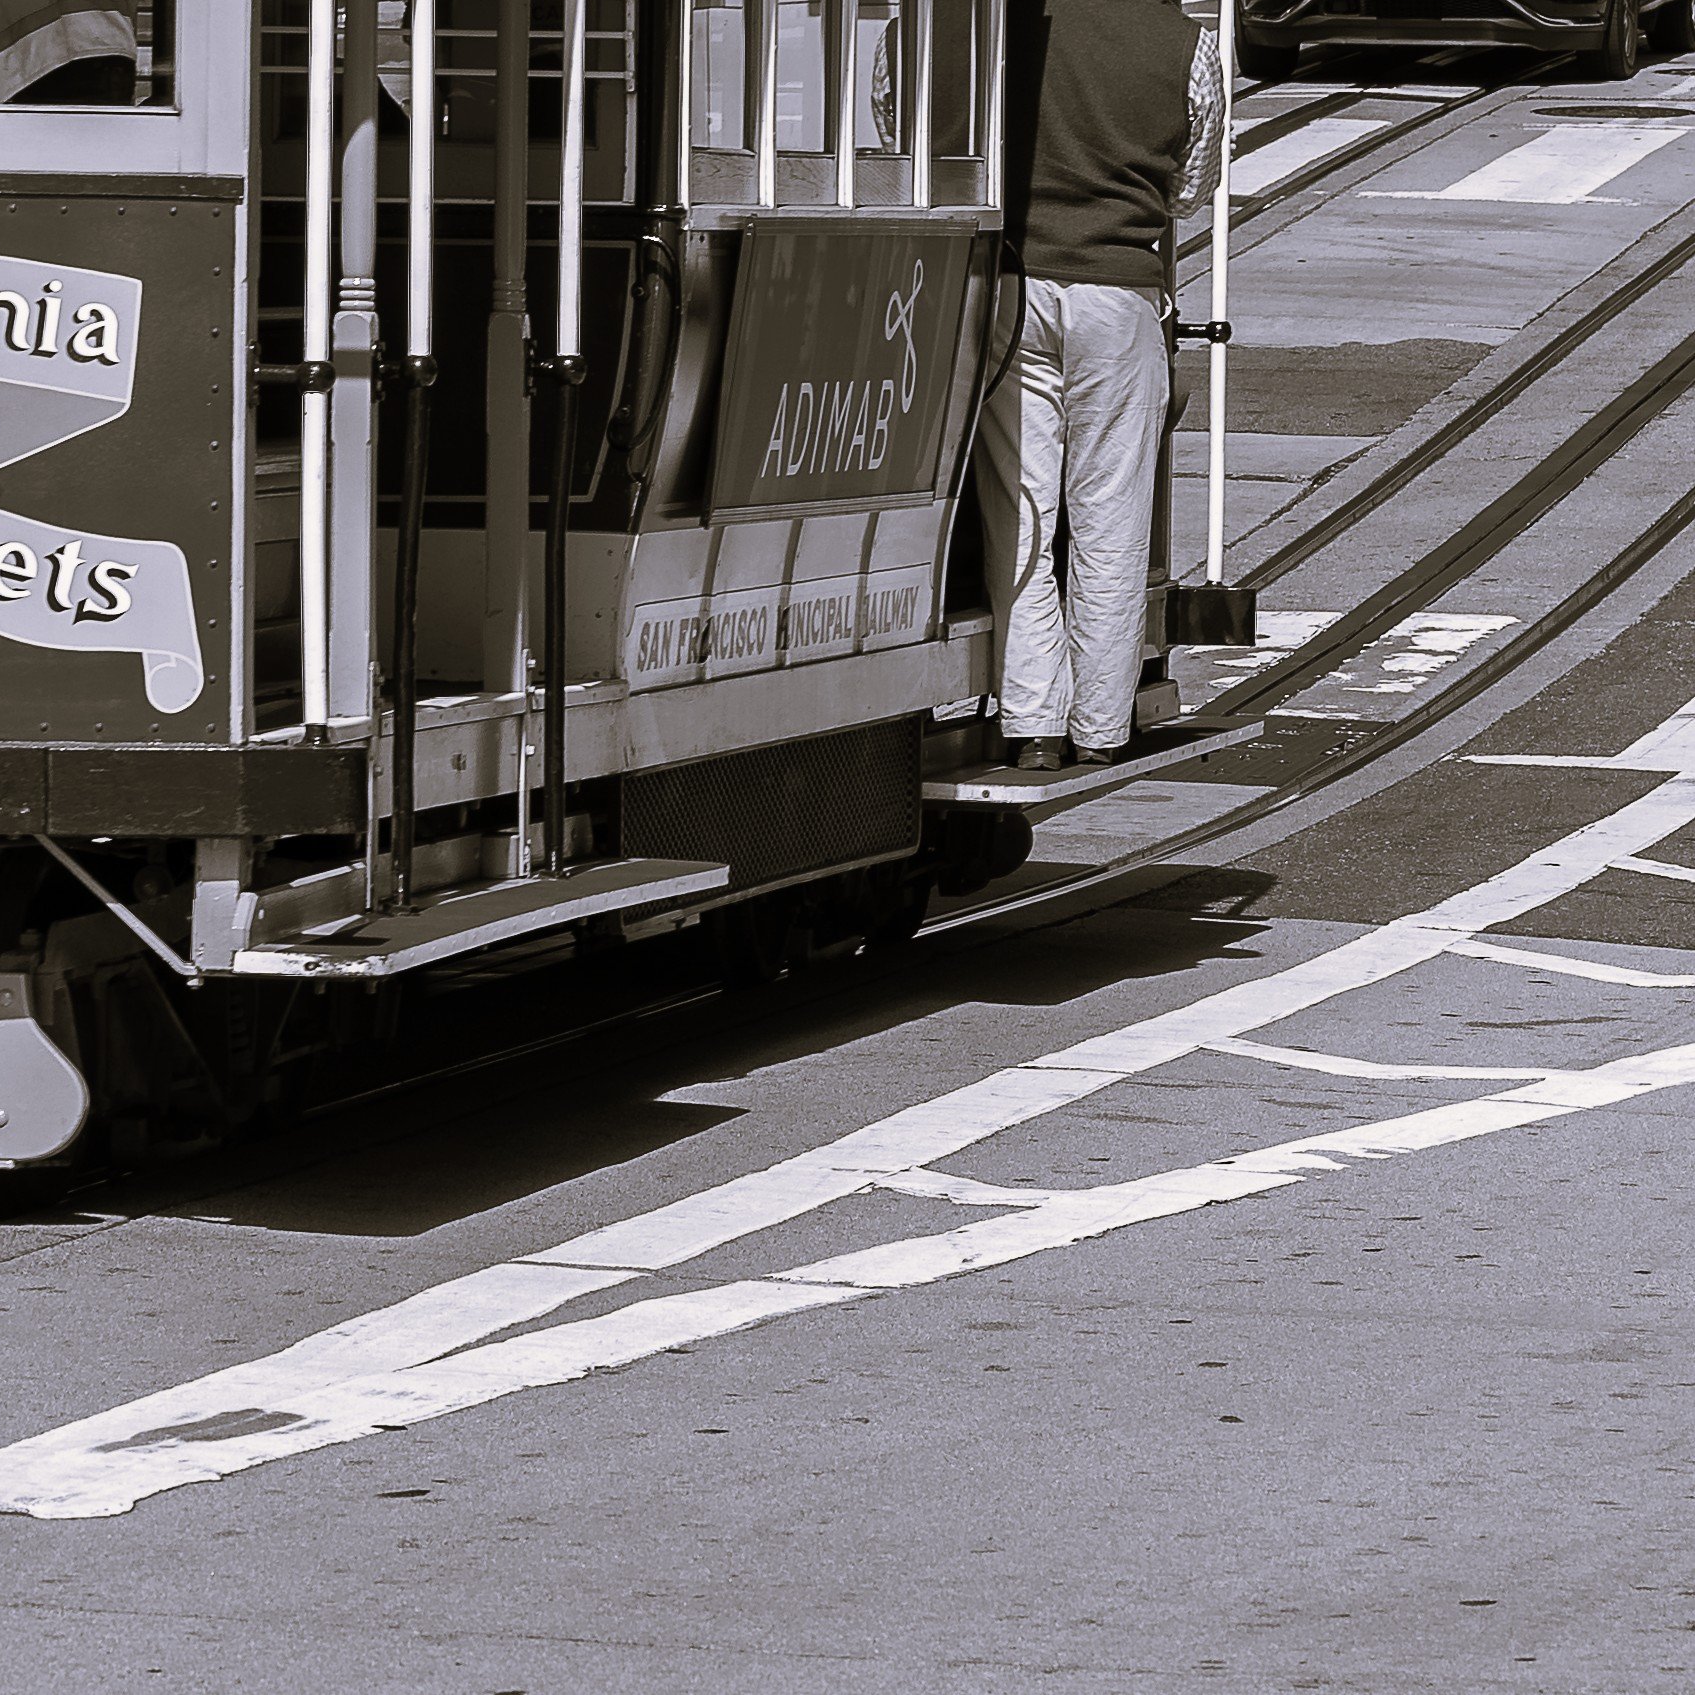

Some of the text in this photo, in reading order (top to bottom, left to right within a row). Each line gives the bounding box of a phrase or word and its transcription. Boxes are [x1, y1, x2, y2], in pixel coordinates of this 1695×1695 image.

[761, 379, 895, 480] ADIMAB
[636, 618, 673, 673] SAN
[674, 605, 768, 667] FRANCISCO
[774, 594, 853, 650] MUNICIPAL
